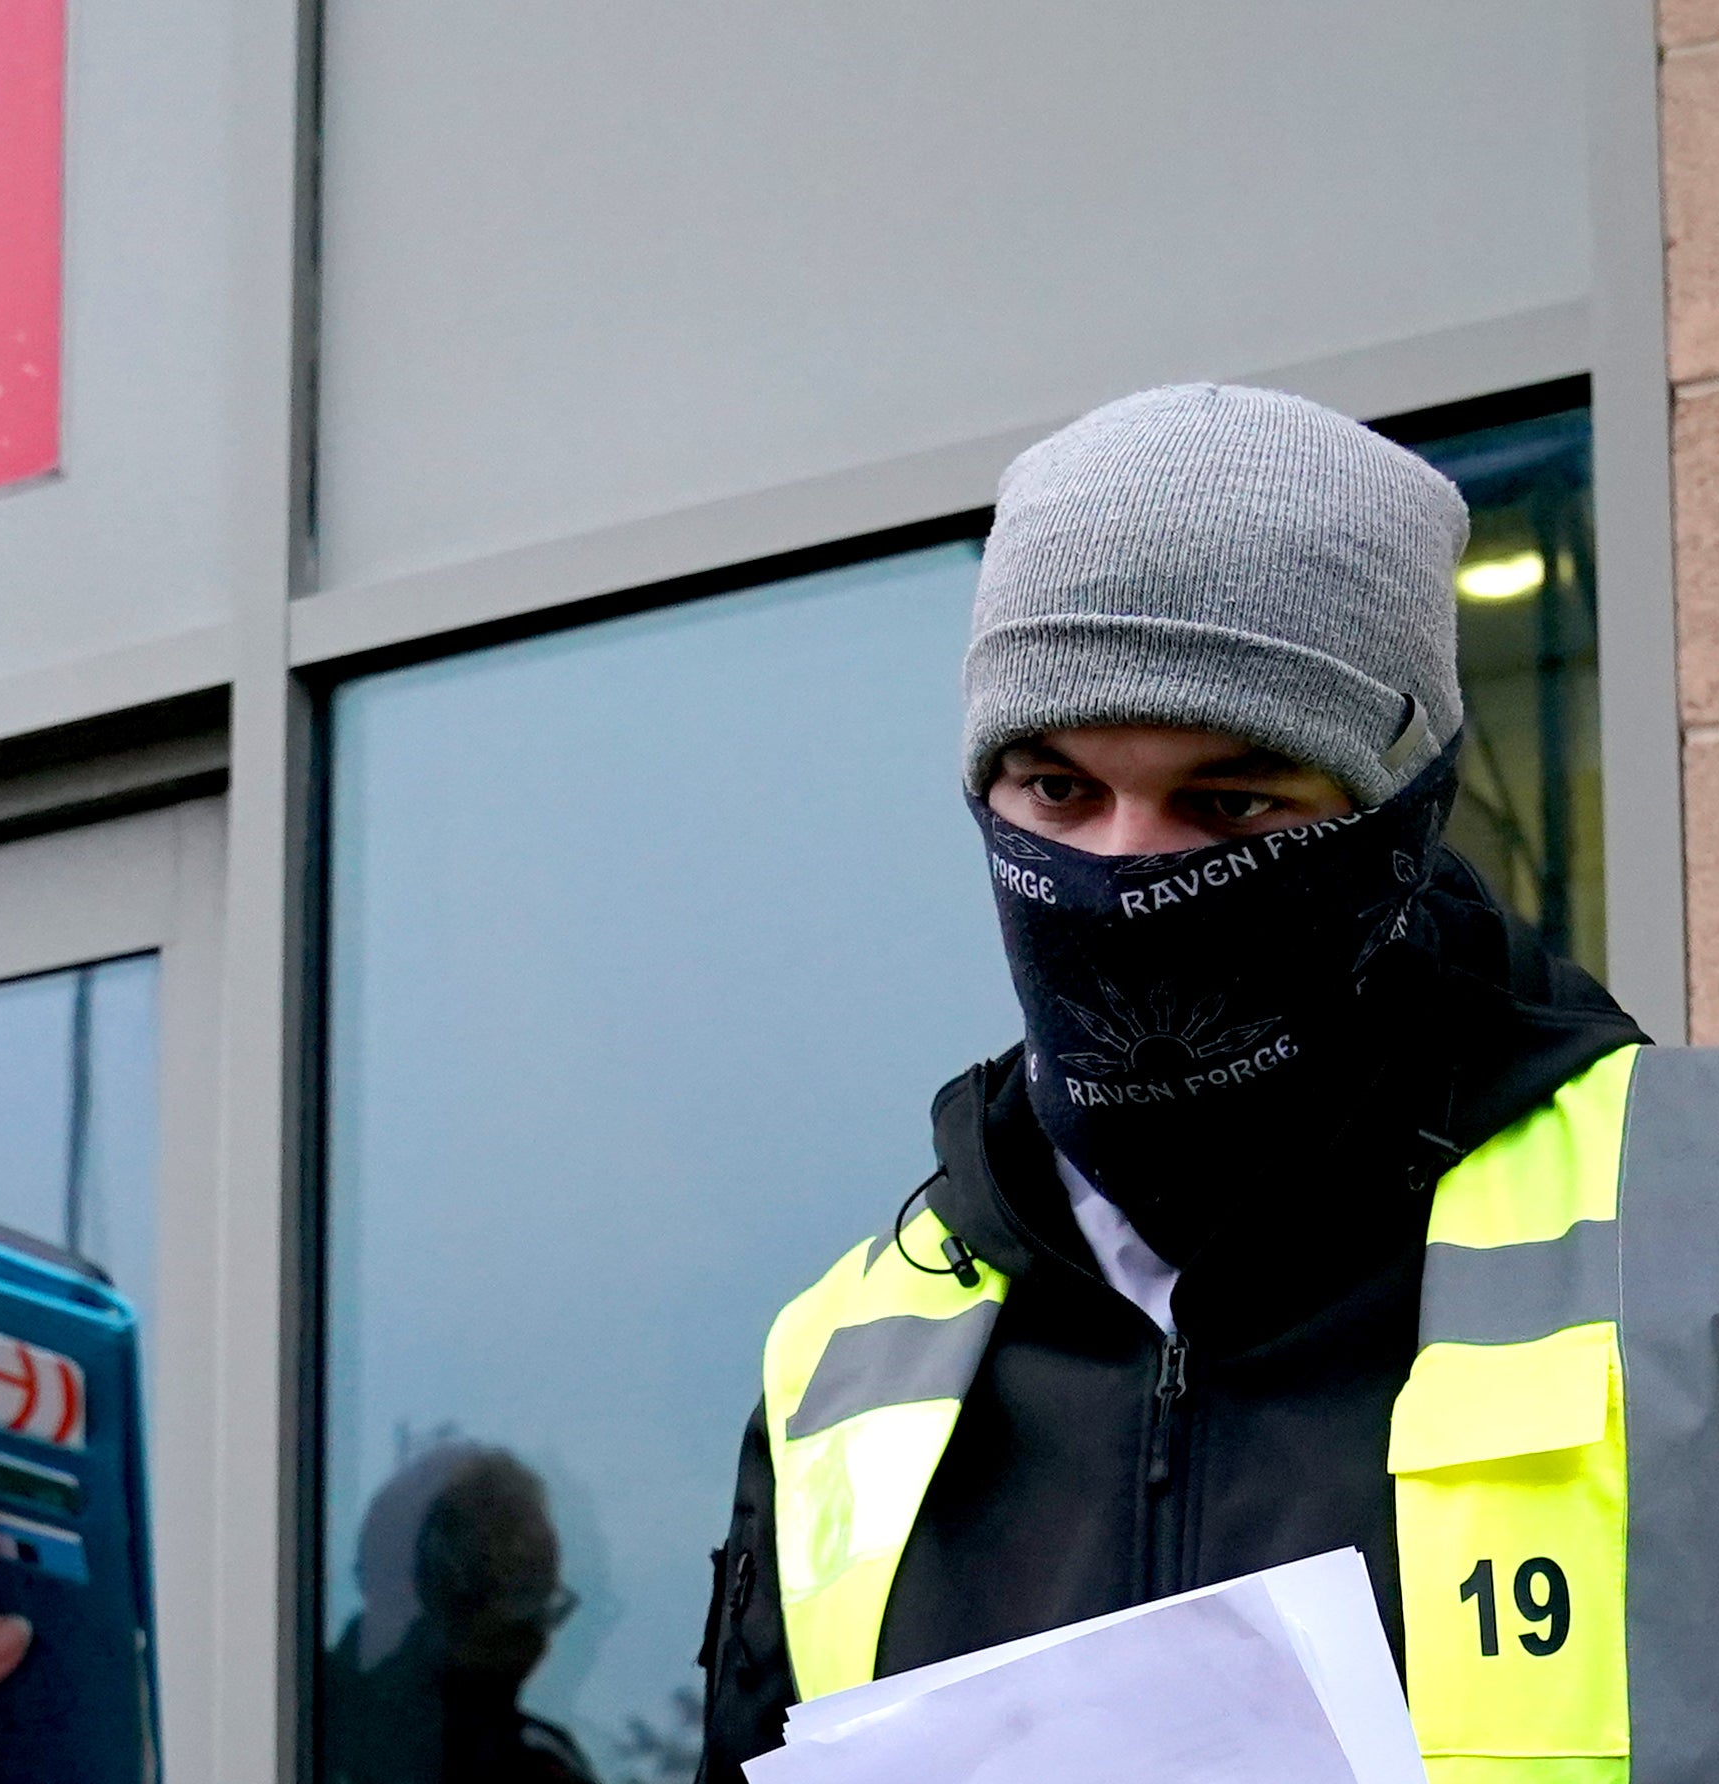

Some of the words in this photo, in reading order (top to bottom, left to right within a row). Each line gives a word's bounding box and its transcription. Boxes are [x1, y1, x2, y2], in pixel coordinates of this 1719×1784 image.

[992, 853, 1057, 905] FORGE
[1120, 847, 1258, 918] RAVEN
[1066, 1077, 1175, 1106] RAVEN
[1185, 1034, 1298, 1097] FORGE
[1459, 1557, 1571, 1657] 19
